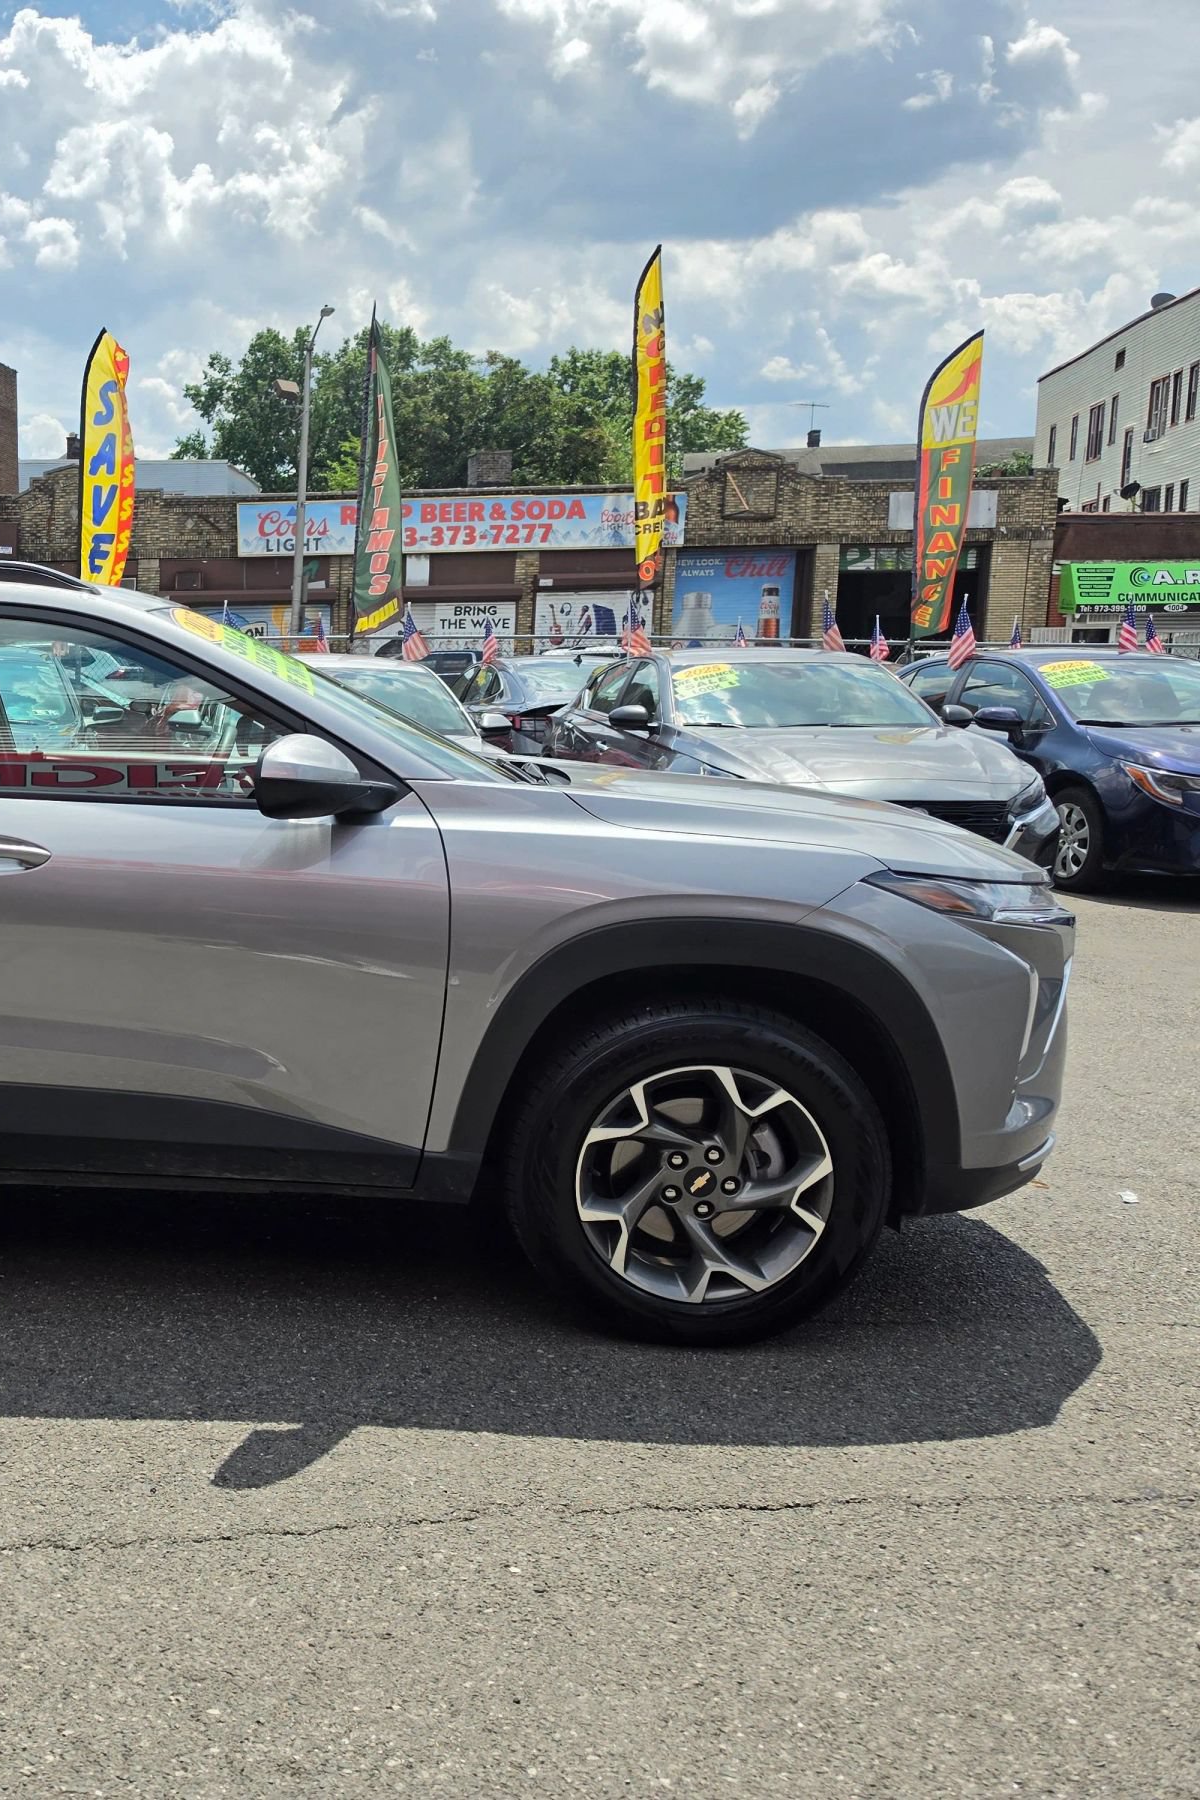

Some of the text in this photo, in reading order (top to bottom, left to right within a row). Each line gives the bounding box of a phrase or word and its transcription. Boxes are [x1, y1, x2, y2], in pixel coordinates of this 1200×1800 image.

[929, 401, 976, 442] WE
[88, 380, 119, 575] SAVE
[420, 503, 487, 523] BEER
[489, 502, 507, 521] &
[510, 500, 586, 520] SODA
[913, 448, 961, 628] FINANCE
[681, 569, 715, 577] ALWAYS
[725, 554, 790, 578] Chill
[453, 605, 498, 617] BRING
[439, 618, 511, 630] THE WVE
[684, 676, 728, 691] SALE
